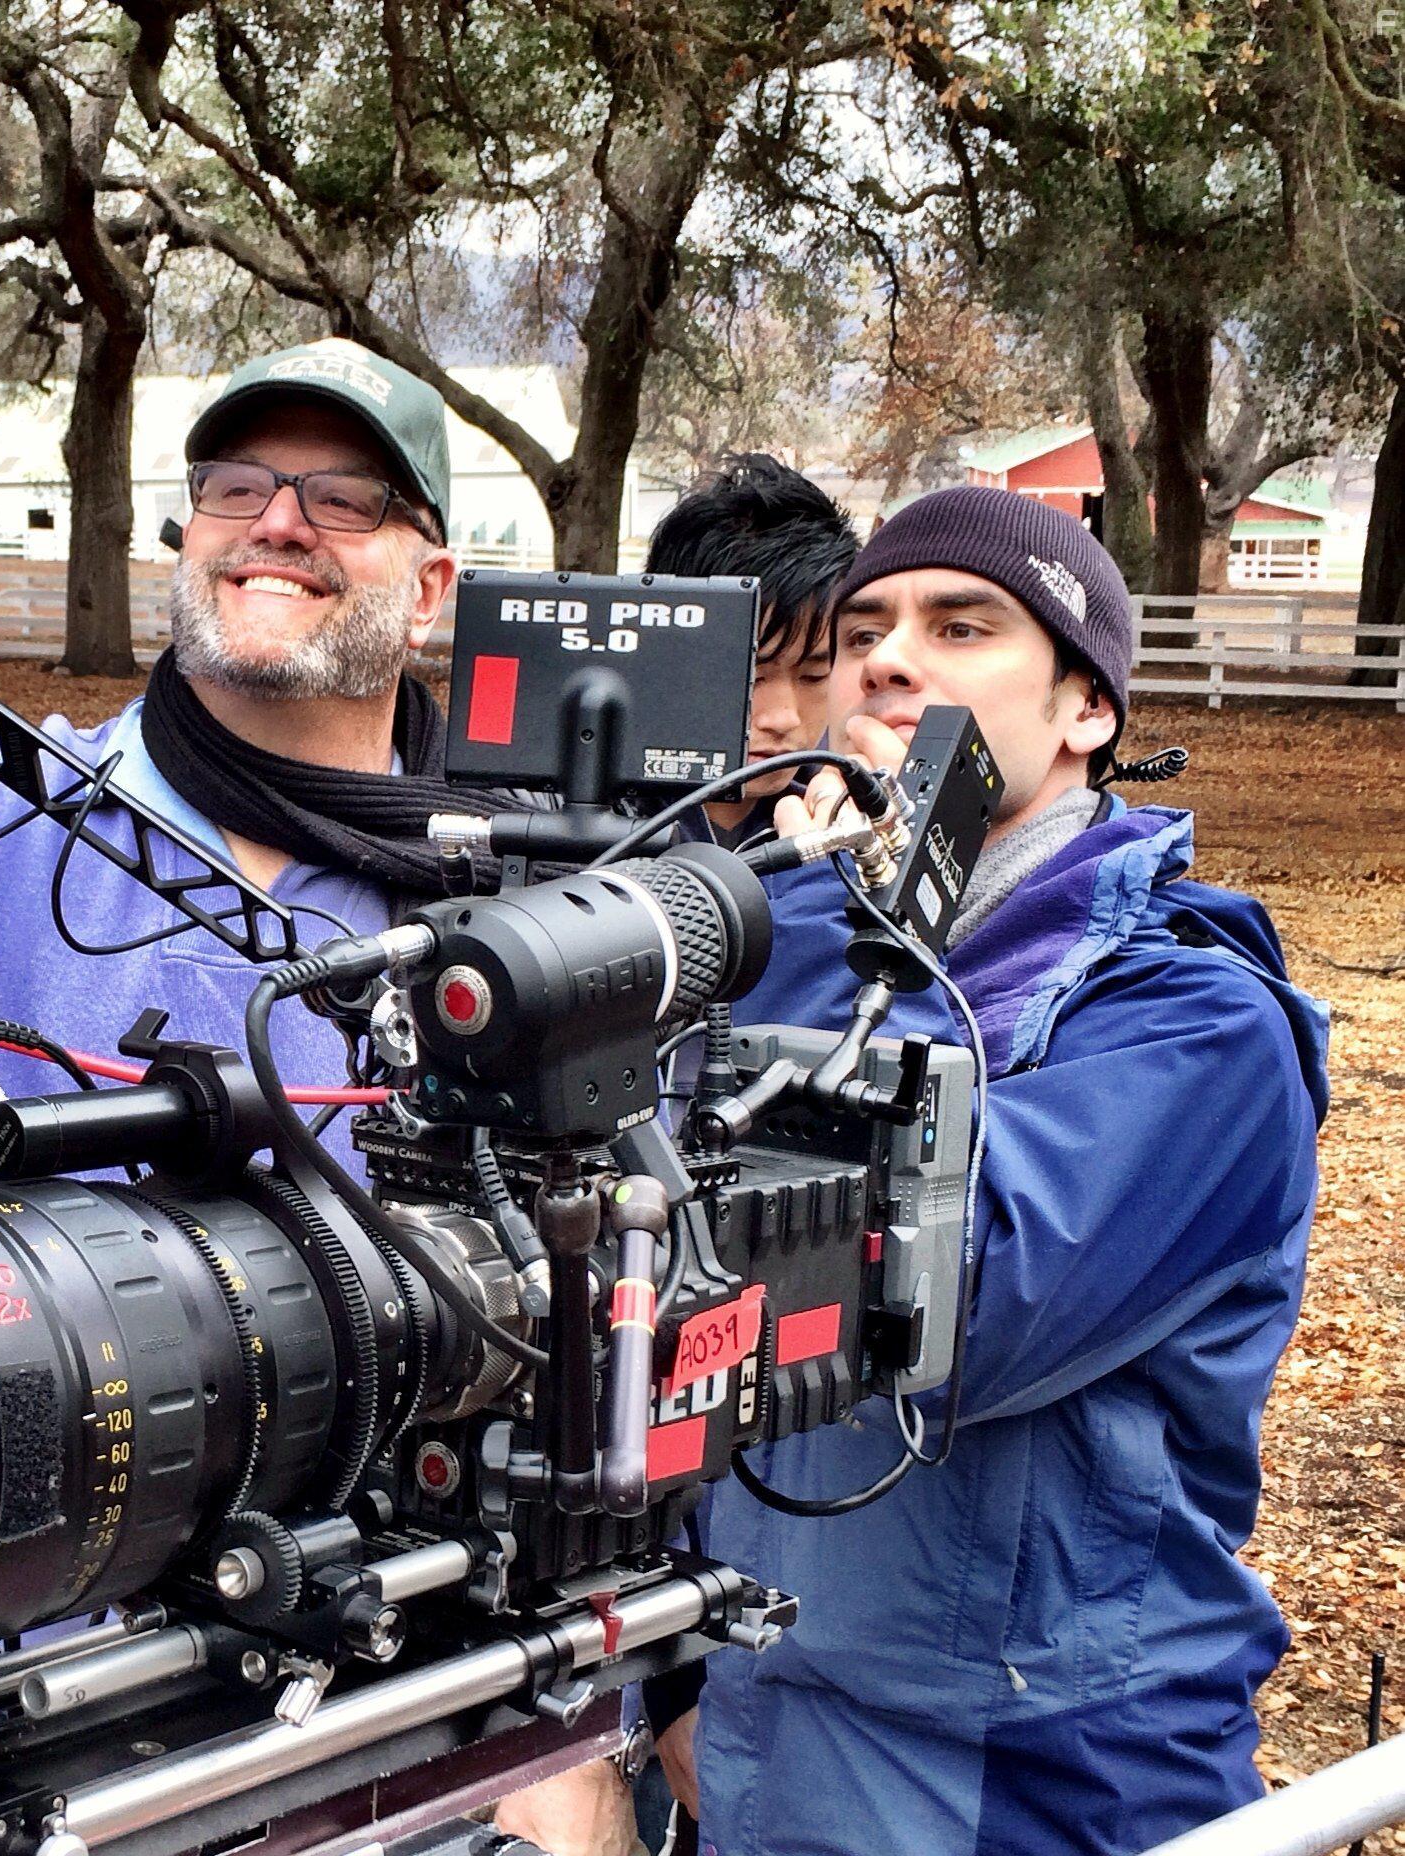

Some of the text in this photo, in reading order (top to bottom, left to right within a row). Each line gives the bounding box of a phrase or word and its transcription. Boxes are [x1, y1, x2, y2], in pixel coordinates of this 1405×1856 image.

[1027, 554, 1073, 593] NORTH
[499, 598, 706, 628] RED PRO
[560, 626, 639, 653] 5.0
[357, 1140, 433, 1163] WOODEN CAMERA
[448, 1201, 477, 1216] EPIC-X
[101, 1342, 115, 1362] ft
[679, 1313, 738, 1374] A039
[107, 1408, 132, 1433] 120
[111, 1441, 130, 1464] 60
[108, 1472, 127, 1494] 40
[102, 1504, 122, 1525] 30
[94, 1528, 115, 1548] 25
